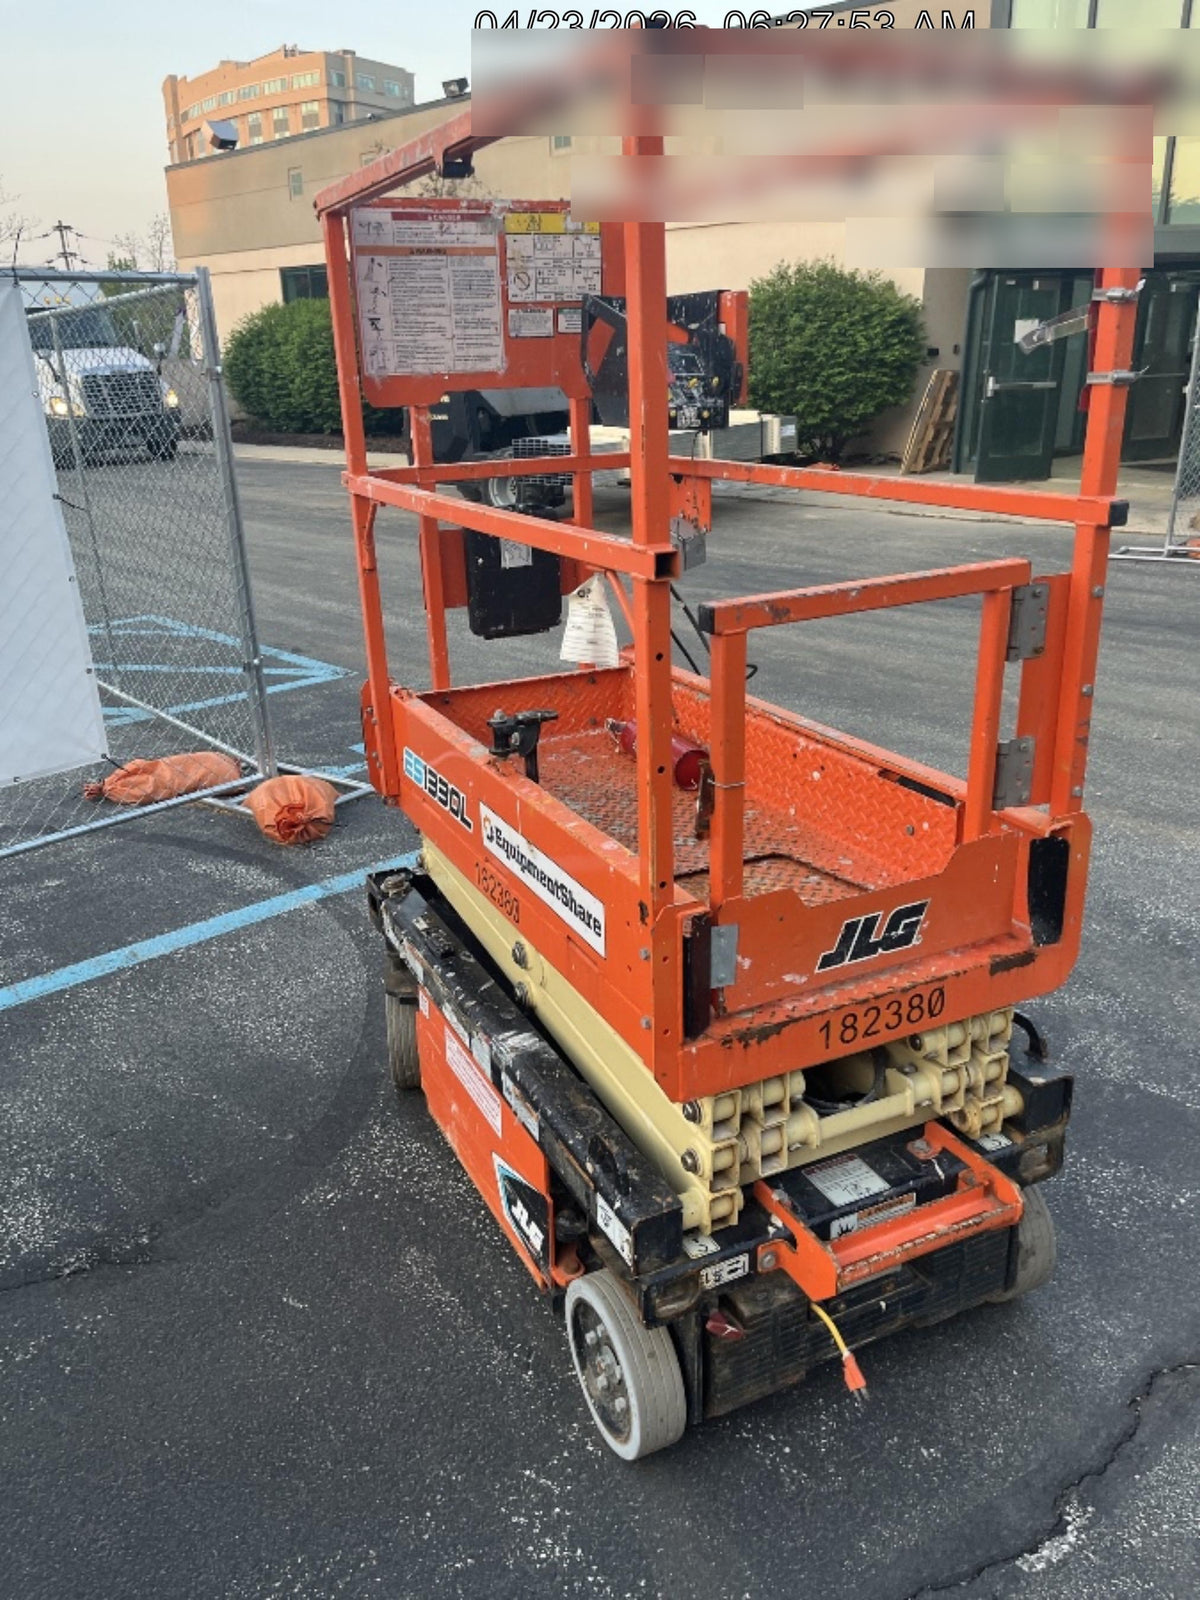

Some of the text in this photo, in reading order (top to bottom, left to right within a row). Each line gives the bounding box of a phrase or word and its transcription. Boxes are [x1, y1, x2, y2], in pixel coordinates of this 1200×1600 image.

[403, 746, 473, 834] ES1330L
[475, 862, 520, 924] 182380
[495, 824, 603, 938] EquipmentShare
[814, 898, 931, 973] JLG
[819, 986, 946, 1050] 182380
